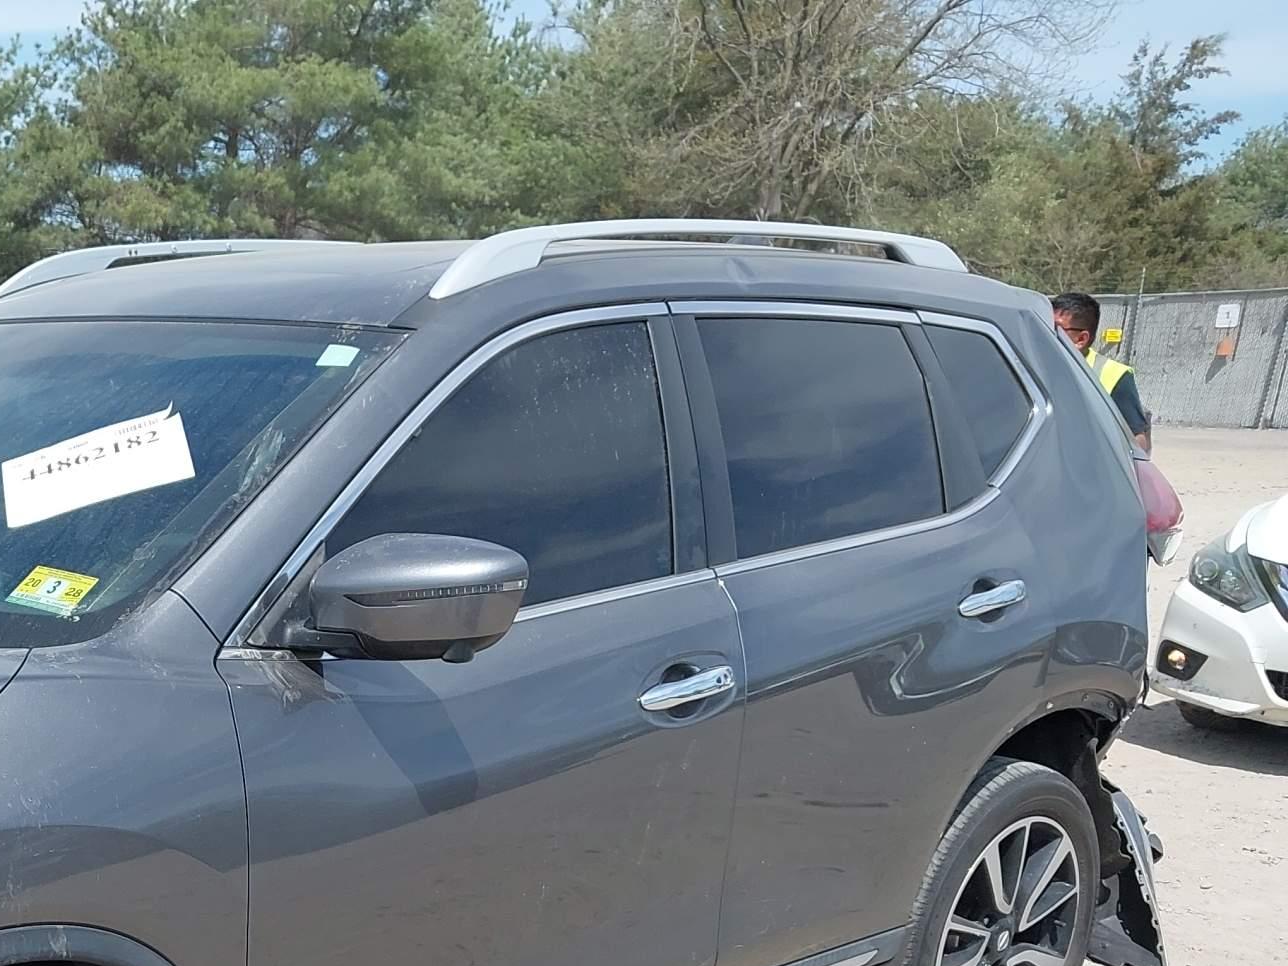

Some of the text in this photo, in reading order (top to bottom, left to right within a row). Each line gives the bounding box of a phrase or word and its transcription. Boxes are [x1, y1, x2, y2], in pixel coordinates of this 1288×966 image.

[22, 430, 160, 481] 44862182
[24, 578, 42, 588] 20
[46, 580, 61, 594] 3
